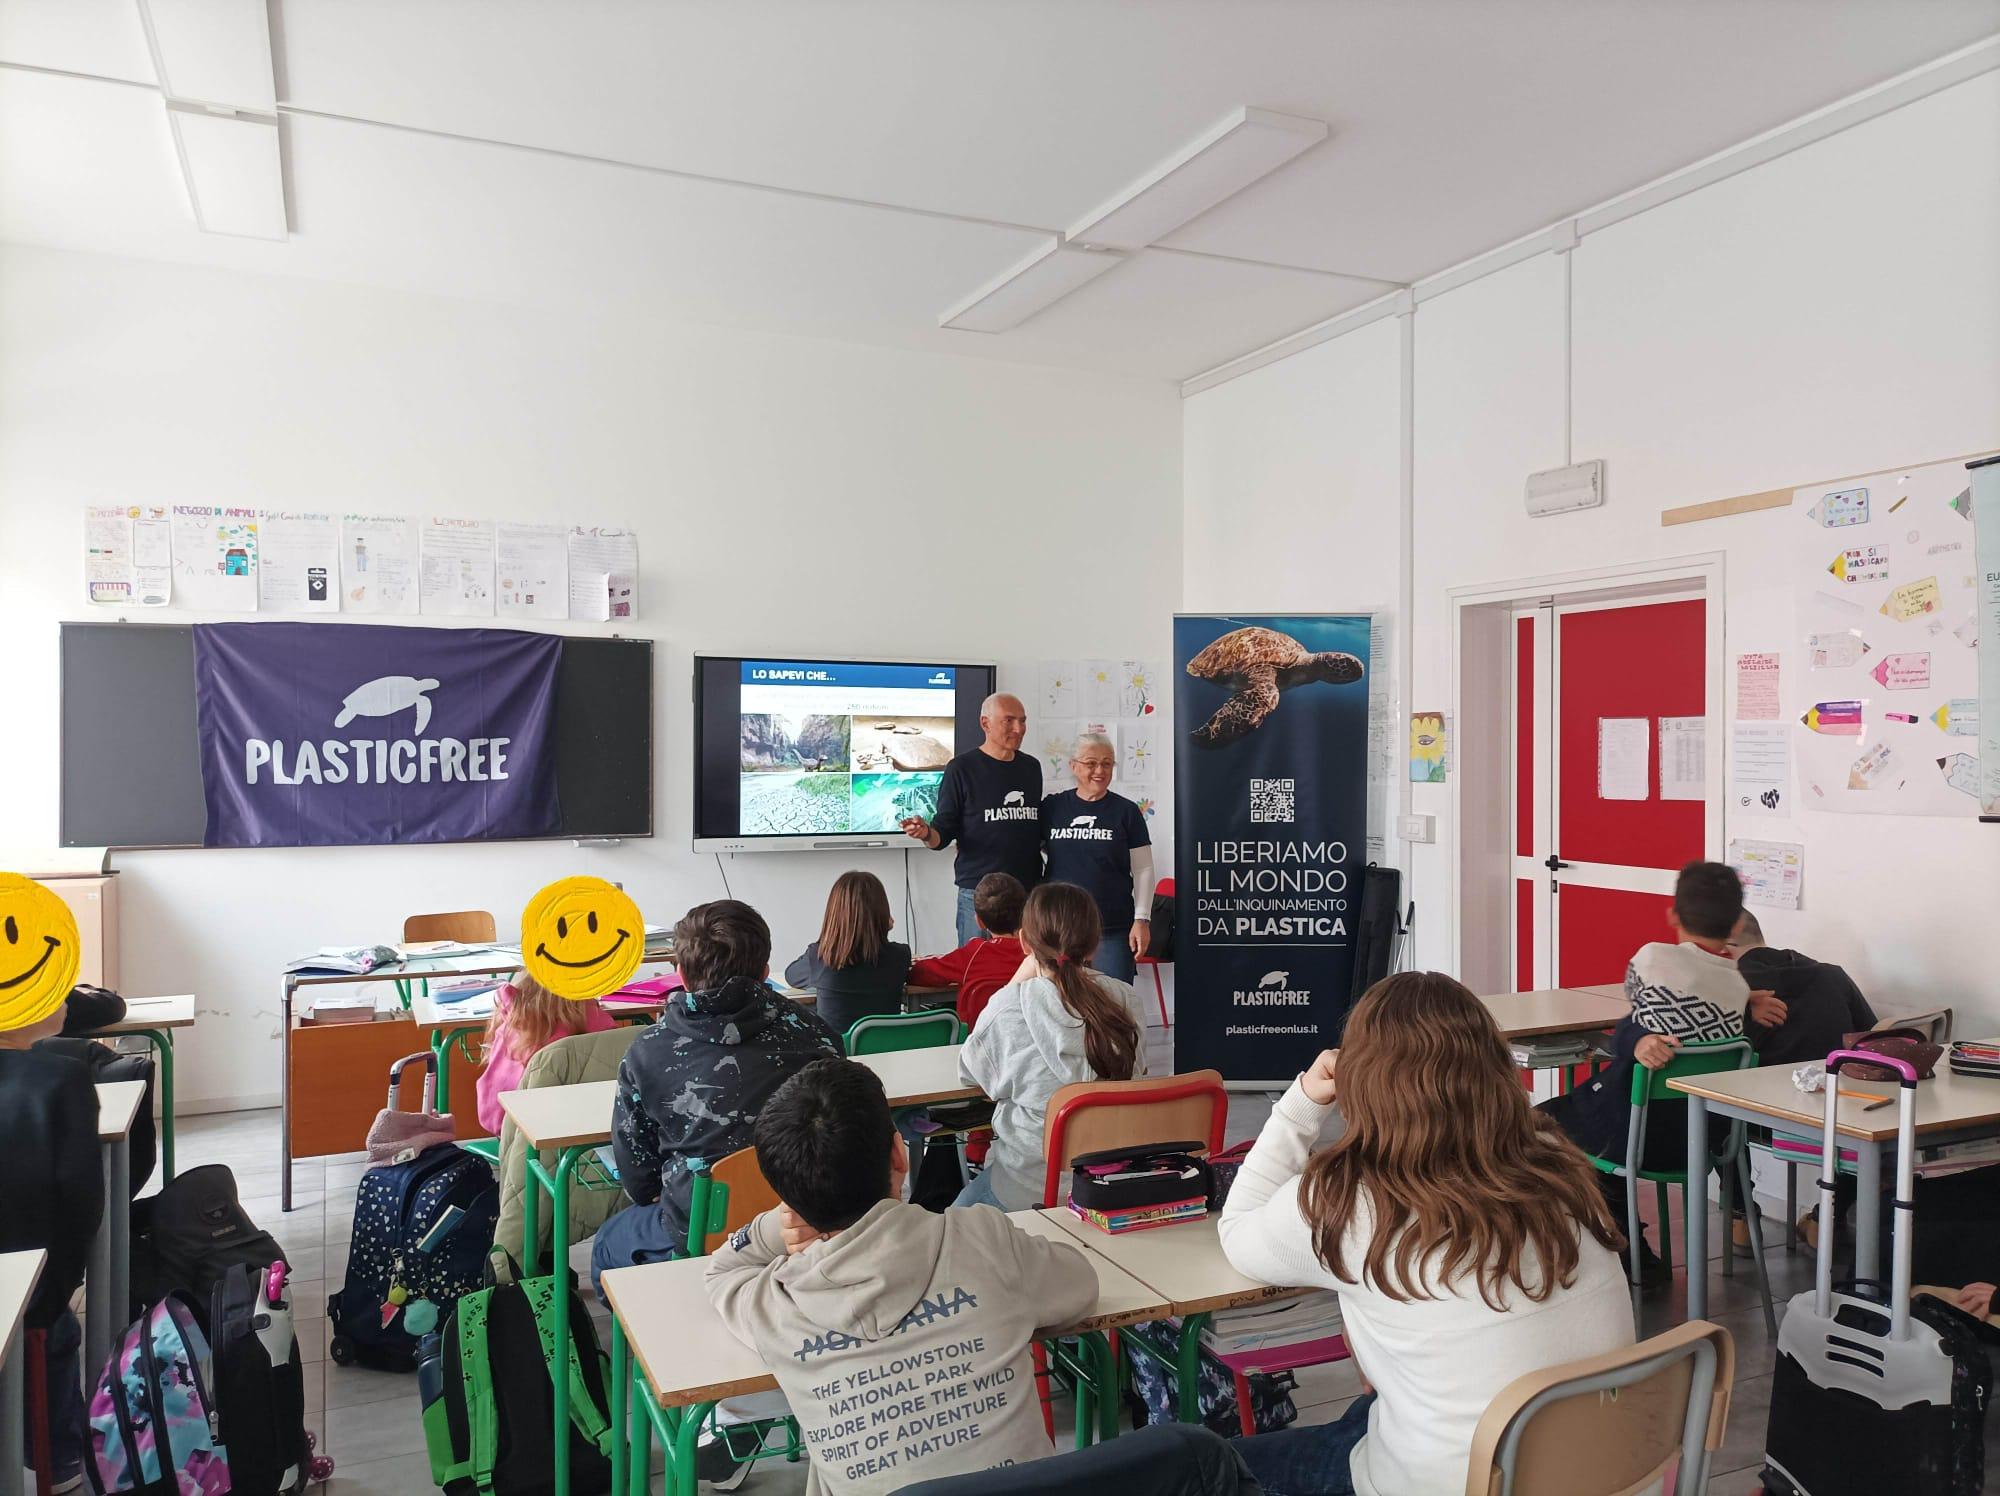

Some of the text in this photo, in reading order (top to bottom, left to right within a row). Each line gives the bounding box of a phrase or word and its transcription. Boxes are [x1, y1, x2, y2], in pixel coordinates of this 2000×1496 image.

[752, 669, 836, 681] LO SAPEVI CHE...
[246, 737, 511, 785] PLASTICFREE
[984, 806, 1038, 823] PLASTICFREE
[1050, 827, 1113, 841] PLASTICFREE
[1197, 841, 1347, 864] LIBERIAMO
[1198, 869, 1347, 892] IL MONDO
[1198, 898, 1347, 911] DALL'INQUINAMENTO
[1198, 917, 1347, 936] DA PLASTICA
[1233, 990, 1311, 1006] PLASTICFREE
[1226, 1024, 1319, 1036] plasticfreeonlus.it
[812, 1338, 985, 1401] THE YELLOWSTONE
[829, 1361, 975, 1418] NATIONAL PARK
[807, 1367, 1015, 1443] EXPLORE MORE THE WILD
[821, 1392, 1008, 1463] SPIRIT OF ADVENTURE
[846, 1423, 981, 1480] GREAT NATURE
